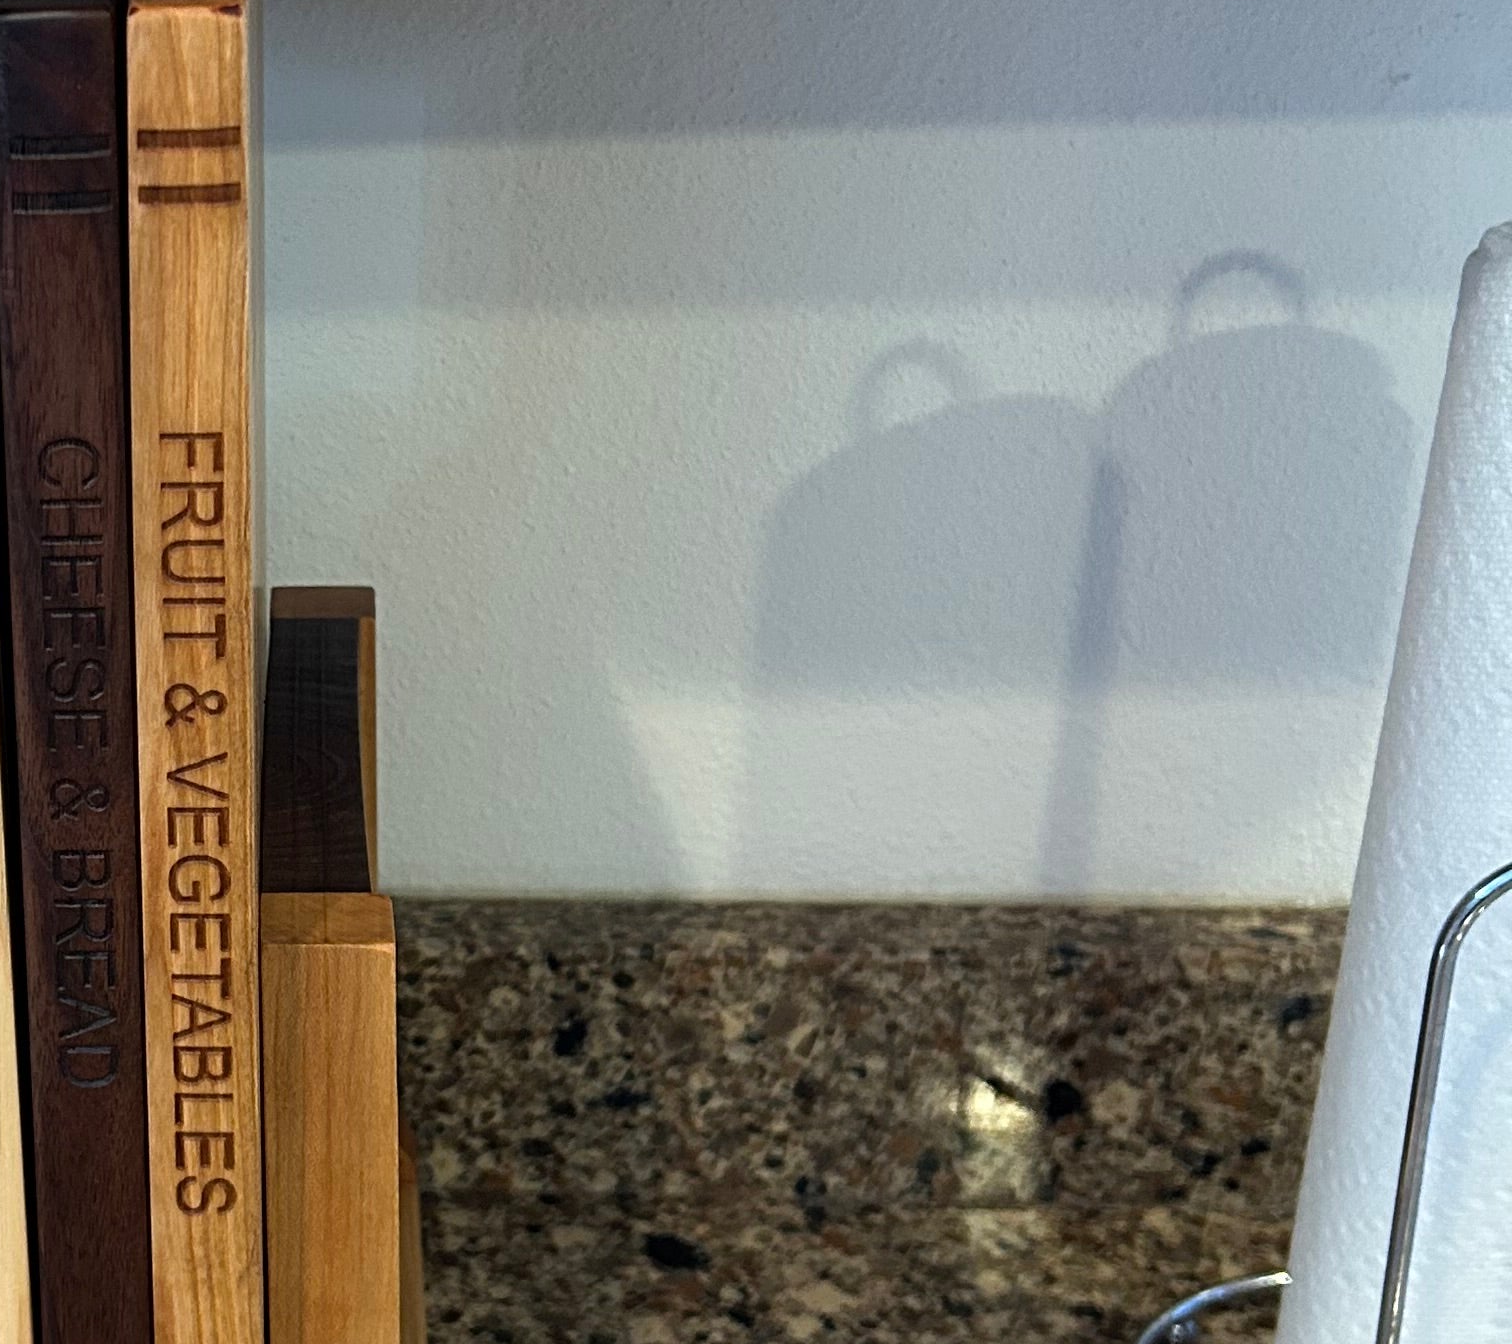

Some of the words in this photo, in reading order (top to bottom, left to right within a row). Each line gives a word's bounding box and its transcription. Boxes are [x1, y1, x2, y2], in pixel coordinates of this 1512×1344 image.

[37, 439, 108, 751] CHEESE
[159, 432, 226, 658] FRUIT
[53, 779, 110, 822] &
[163, 682, 229, 727] &
[53, 851, 118, 1089] BREAD
[165, 751, 237, 1217] VEGETABLES
